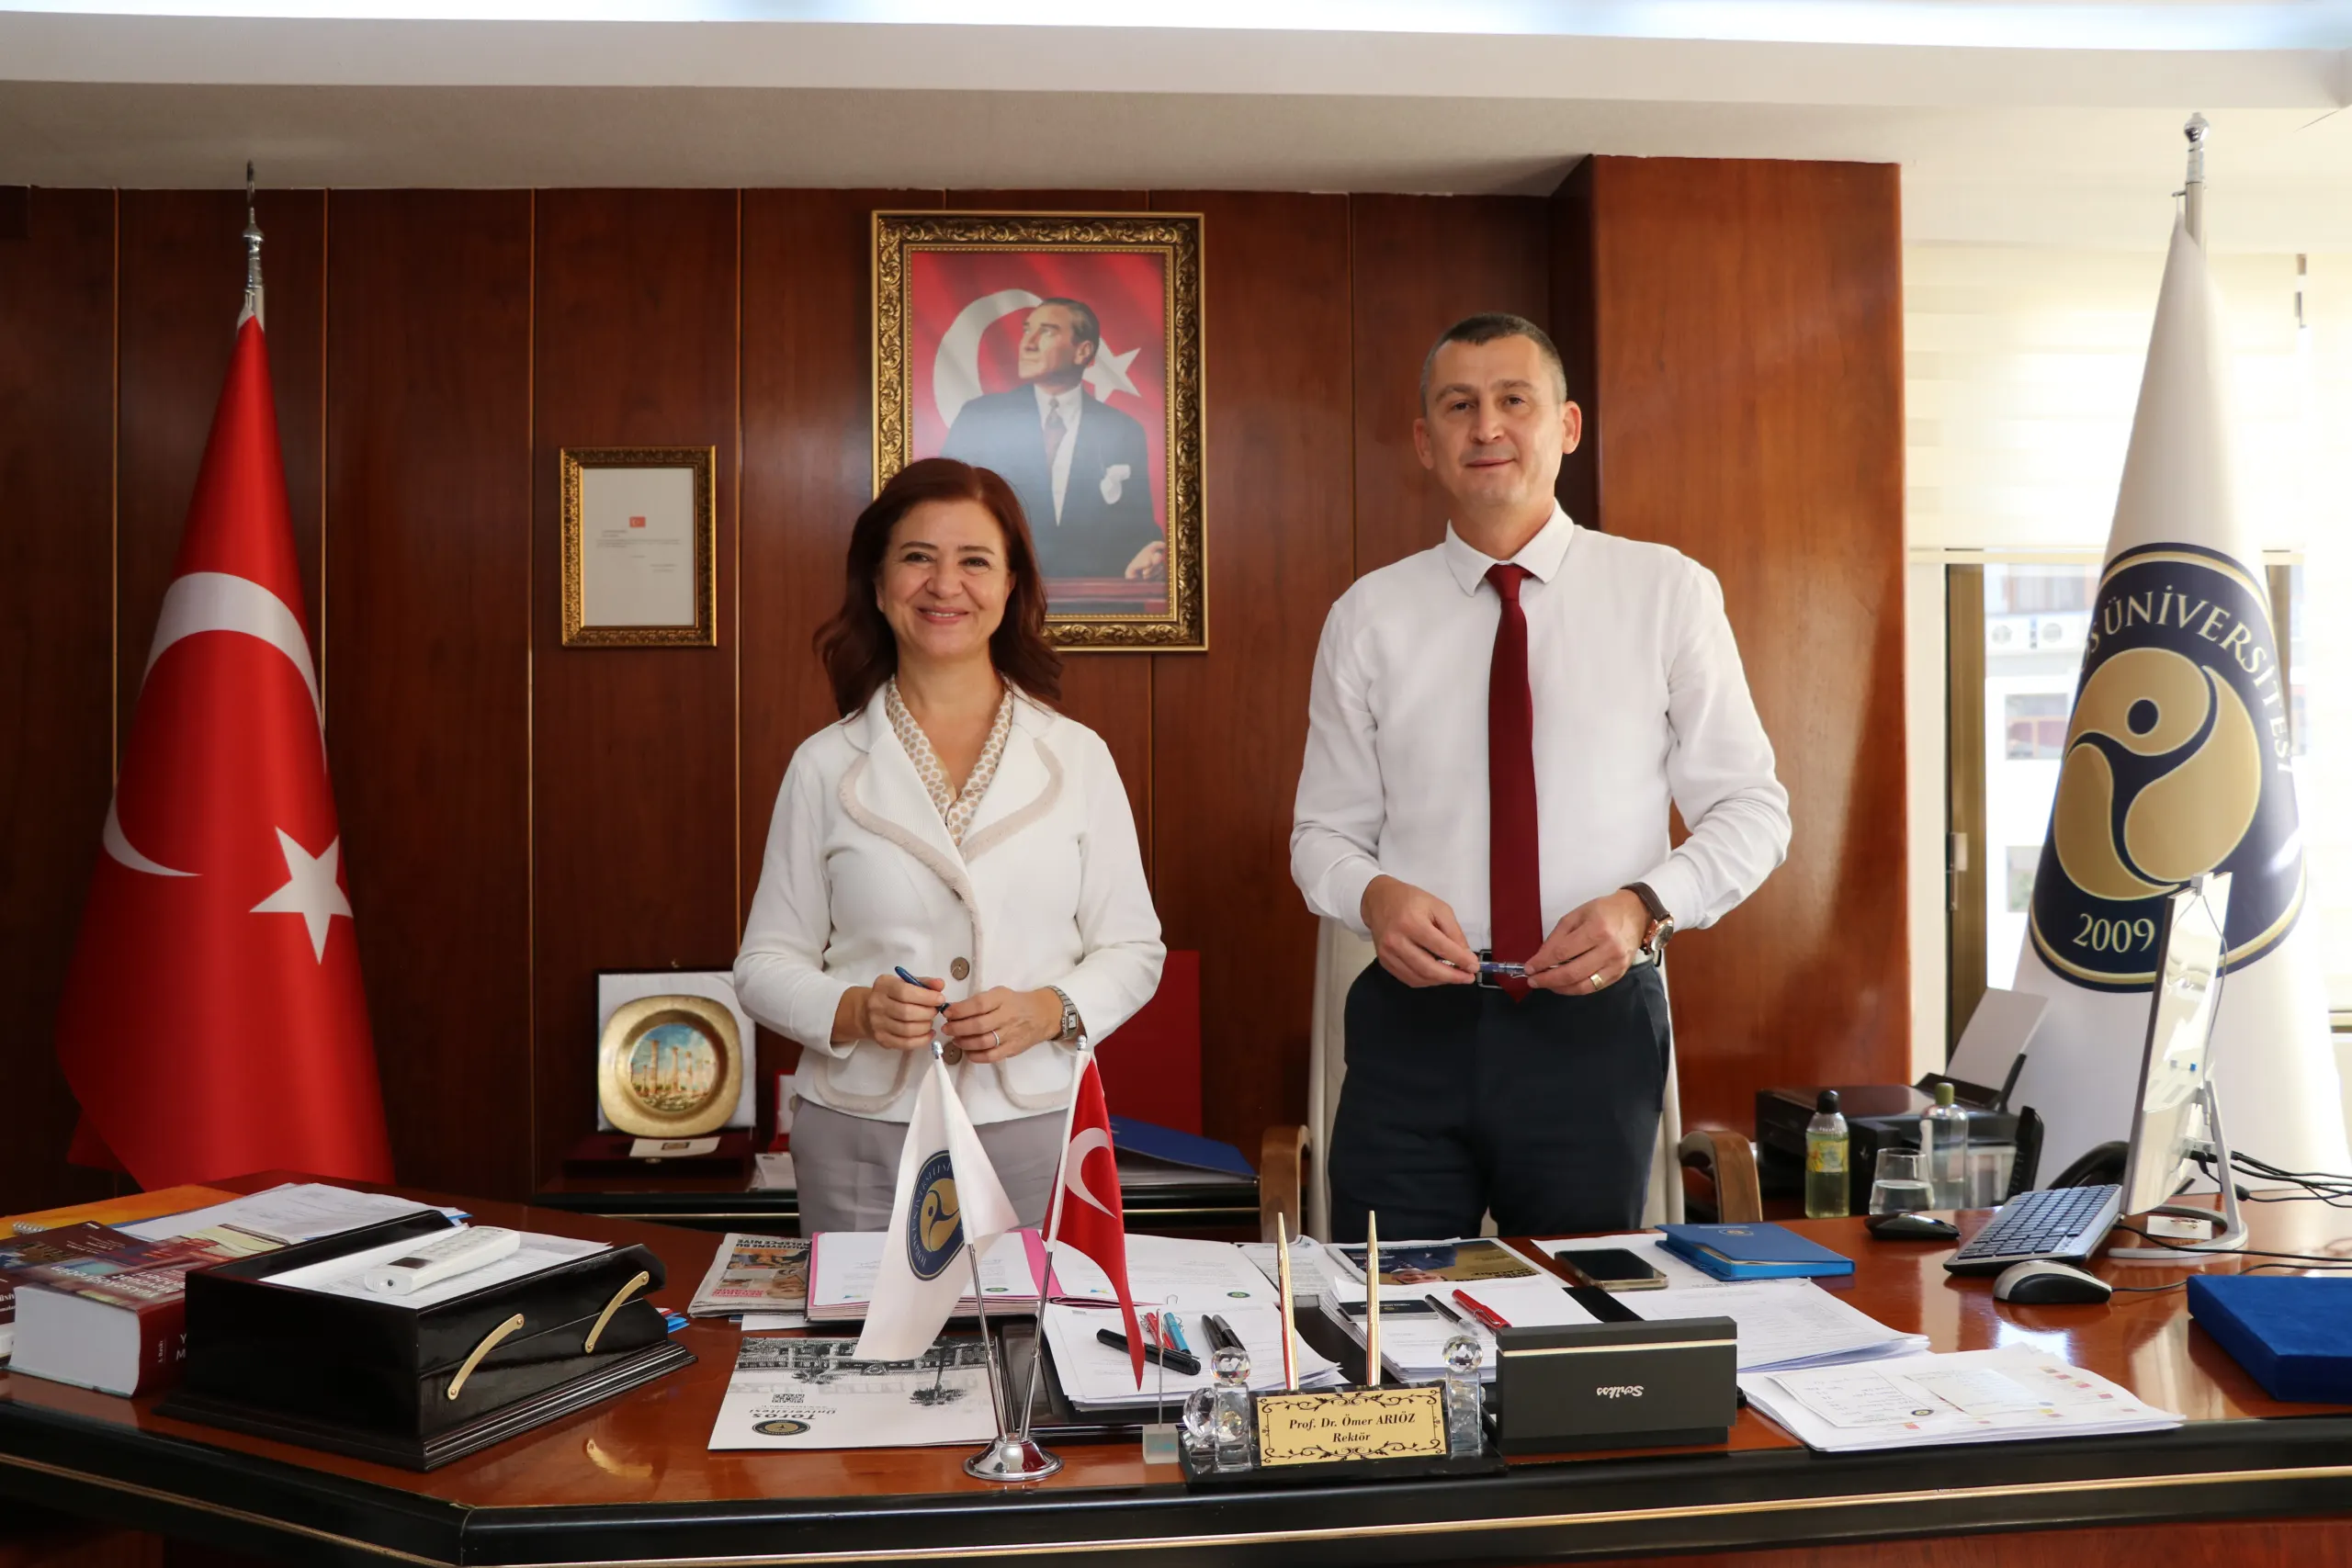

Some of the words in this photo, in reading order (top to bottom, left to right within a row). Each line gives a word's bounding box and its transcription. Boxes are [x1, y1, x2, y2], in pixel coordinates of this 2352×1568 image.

[2072, 913, 2154, 953] 2009
[1596, 1385, 1645, 1399] Scrikss
[1289, 1418, 1317, 1431] Prof.
[1321, 1417, 1337, 1427] Dr.
[1341, 1414, 1374, 1427] Ömer
[1376, 1411, 1415, 1425] ARIÖZ
[1332, 1432, 1371, 1442] Rektör
